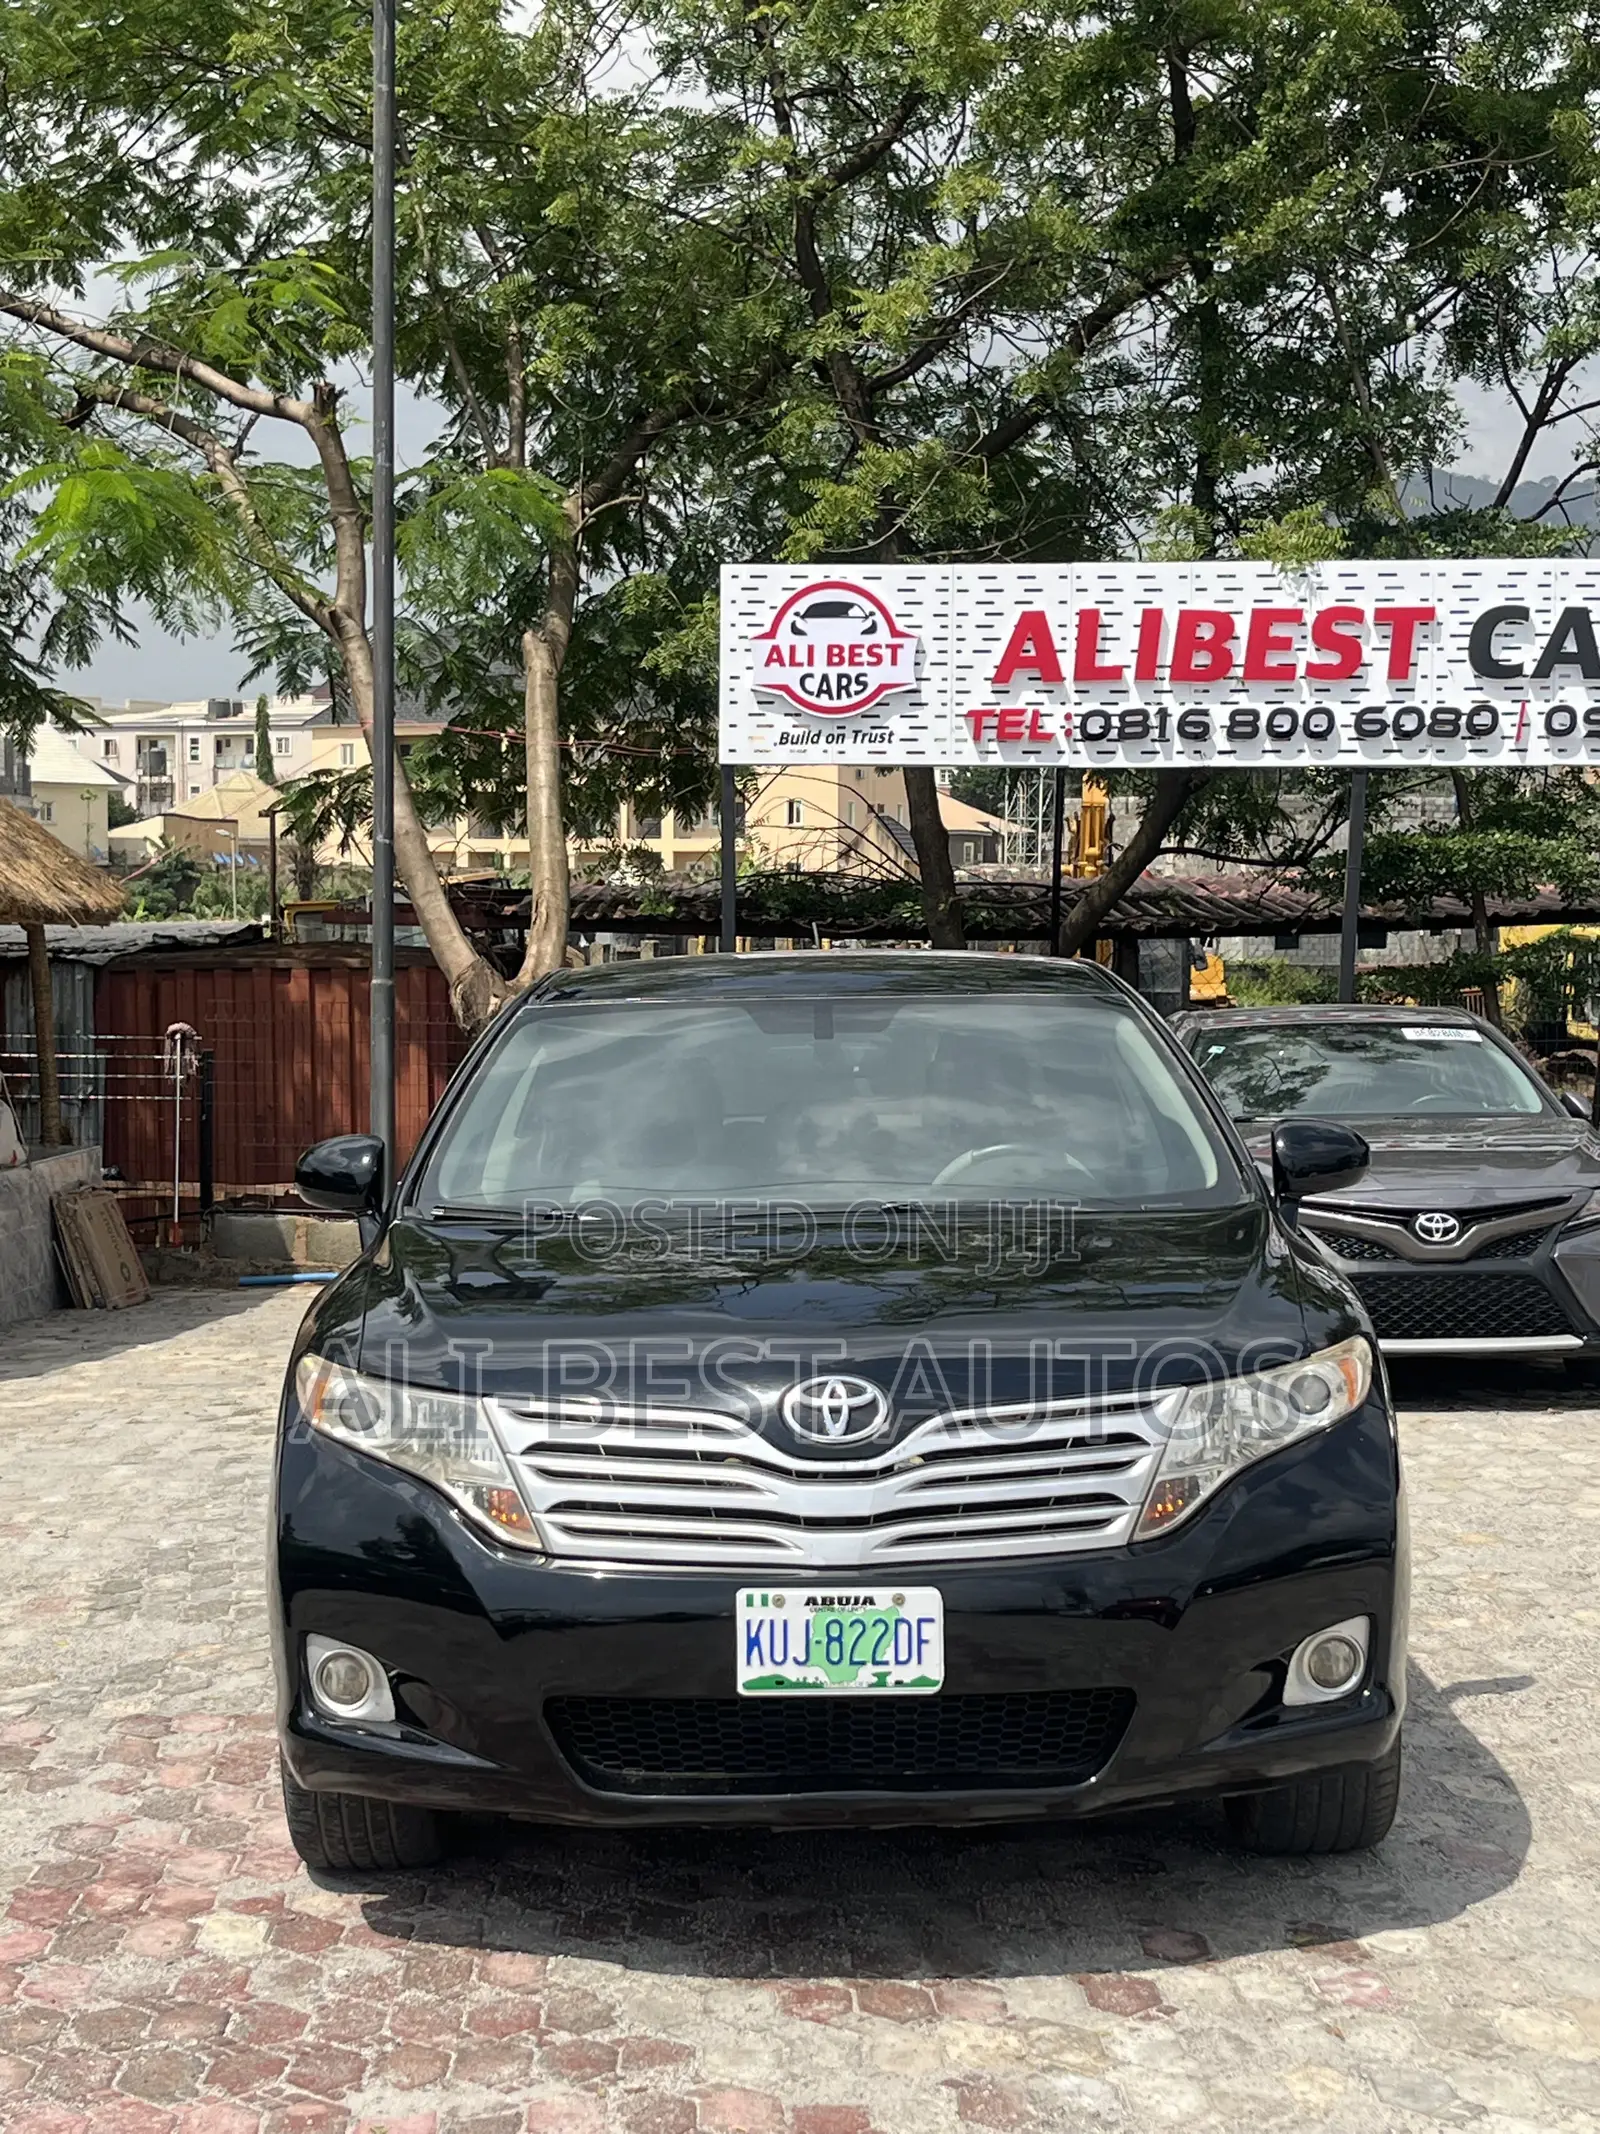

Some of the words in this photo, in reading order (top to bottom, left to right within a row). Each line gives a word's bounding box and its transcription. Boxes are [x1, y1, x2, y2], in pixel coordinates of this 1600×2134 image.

[764, 644, 815, 667] ALI
[827, 643, 904, 667] BEST
[991, 607, 1436, 683] ALIBEST
[1468, 605, 1600, 679] CA
[799, 672, 868, 700] CARS
[1079, 707, 1211, 742] 0816
[1227, 705, 1337, 741] 800
[1353, 704, 1499, 740] 6080
[778, 729, 822, 746] Build
[825, 732, 846, 744] on
[852, 729, 895, 744] Trust
[804, 1596, 876, 1606] ABUJA
[746, 1618, 935, 1667] KUJ-822DF
